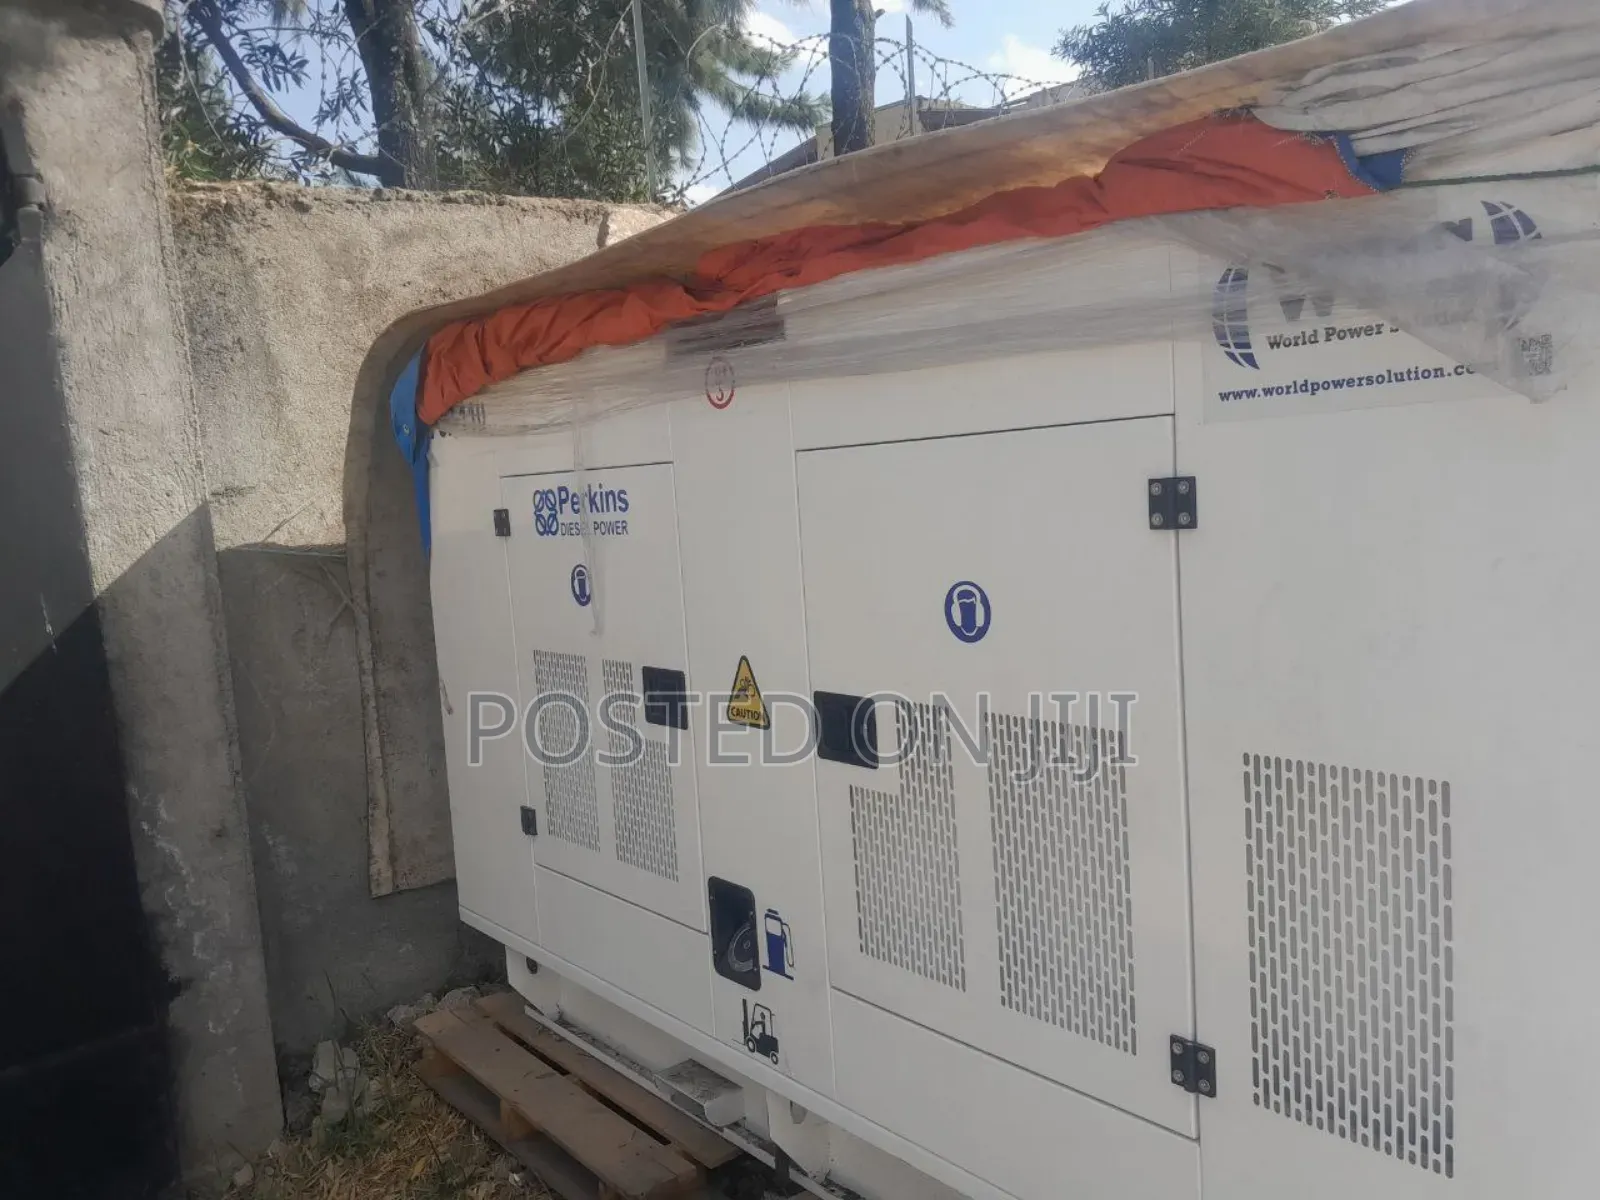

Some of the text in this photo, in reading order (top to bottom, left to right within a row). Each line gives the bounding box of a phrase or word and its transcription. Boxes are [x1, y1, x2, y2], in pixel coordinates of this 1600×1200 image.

[1267, 328, 1319, 350] World
[1324, 323, 1385, 343] Power
[1218, 364, 1476, 402] www.worldpowersolution.co
[560, 520, 629, 536] DIES POWER
